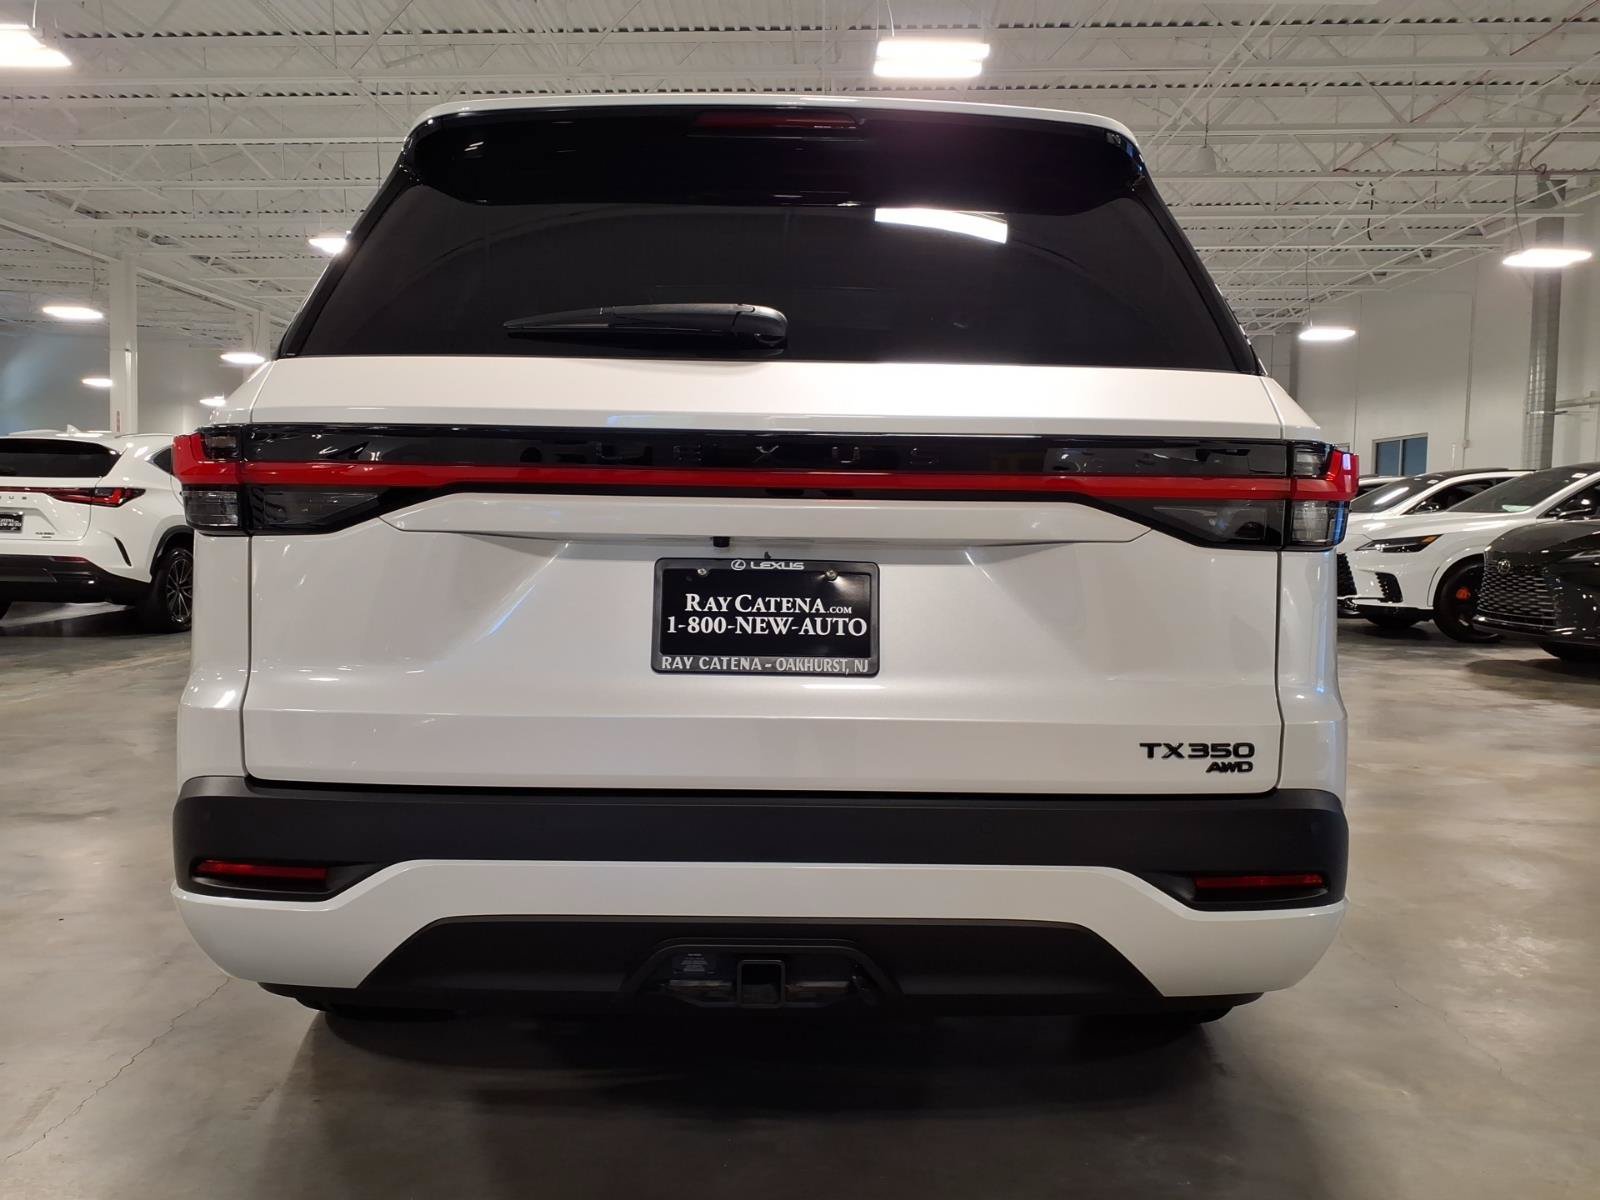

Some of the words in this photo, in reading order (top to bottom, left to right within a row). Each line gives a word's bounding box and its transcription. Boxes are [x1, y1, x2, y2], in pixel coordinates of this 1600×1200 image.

[750, 561, 804, 570] LEXUS
[667, 616, 867, 636] 1-800-NEW-AUTO
[661, 656, 693, 670] RAY
[698, 657, 762, 671] CATENA
[775, 658, 849, 675] OAKHURST,
[854, 660, 868, 672] NJ
[1205, 761, 1254, 773] AWD
